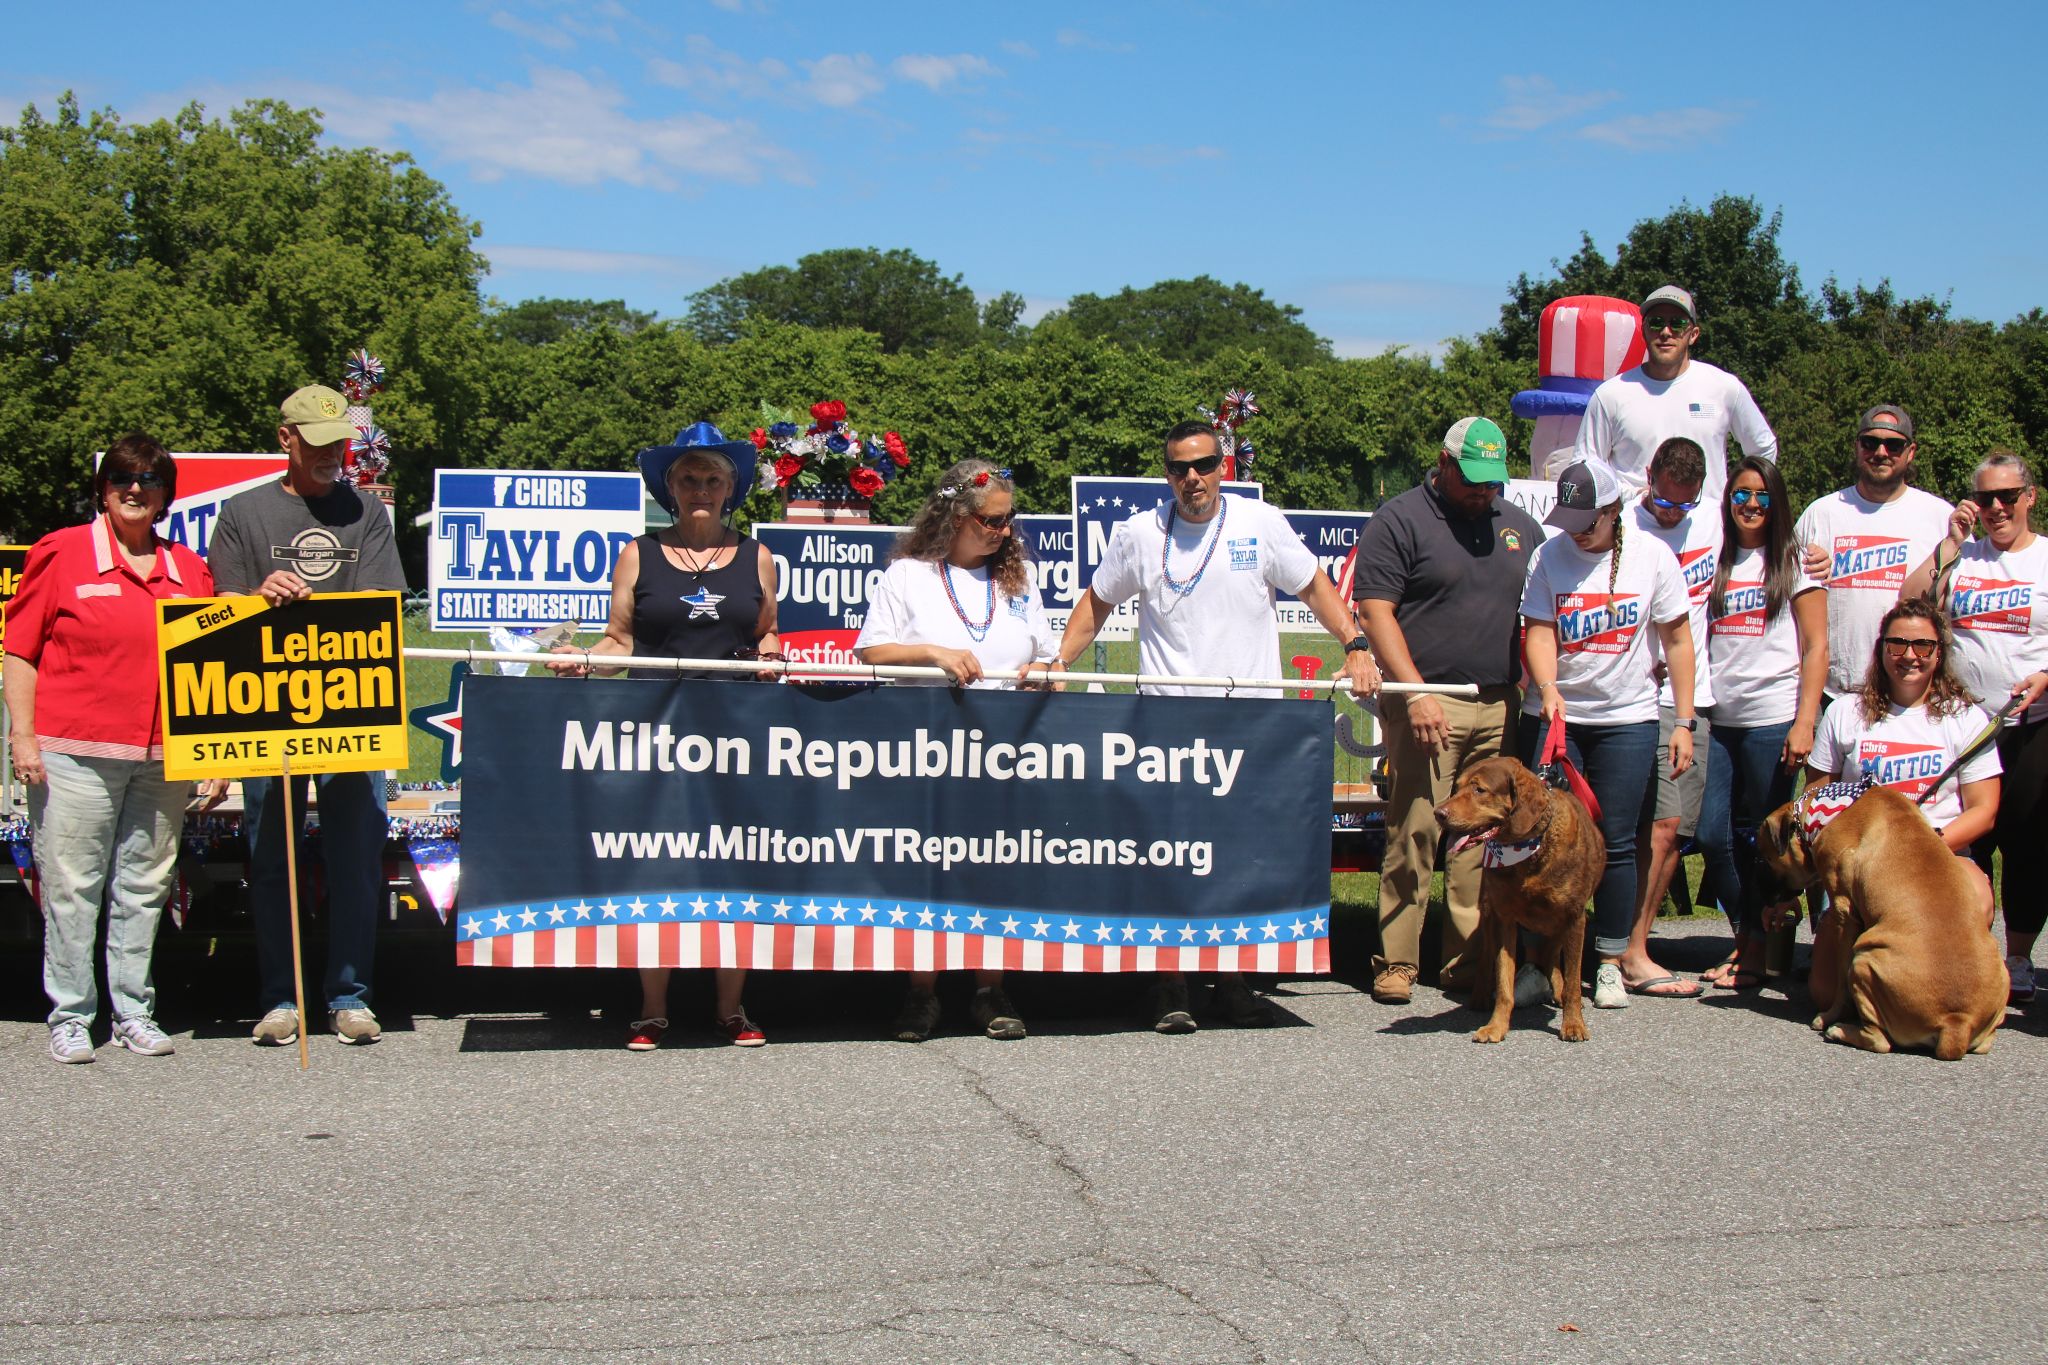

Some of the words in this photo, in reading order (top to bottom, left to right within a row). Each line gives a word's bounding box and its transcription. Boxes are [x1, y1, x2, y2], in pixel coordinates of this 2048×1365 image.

[515, 477, 586, 507] CHRIS
[298, 550, 334, 560] Morgan
[800, 535, 873, 564] Allison
[1836, 536, 1858, 548] Chris
[1832, 544, 1908, 578] MATTOS
[1884, 570, 1904, 581] State
[1957, 576, 1983, 589] Chris
[441, 592, 492, 619] STATE
[1558, 594, 1585, 609] Chris
[1951, 587, 2032, 619] MATTOS
[195, 605, 236, 631] Elect
[843, 607, 865, 630] for
[1559, 600, 1639, 643] MATTOS
[1744, 615, 1765, 625] State
[2006, 613, 2030, 624] State
[261, 621, 393, 664] Leland
[173, 660, 394, 724] Morgan
[193, 740, 269, 761] STATE
[285, 734, 382, 756] SENATE
[561, 720, 751, 775] Milton
[767, 726, 1085, 790] Republican
[1102, 732, 1245, 797] Party
[1862, 741, 1888, 754] Chris
[1860, 753, 1943, 785] MATTOS
[591, 825, 1213, 876] www.MiltonVTRepublicans.org
